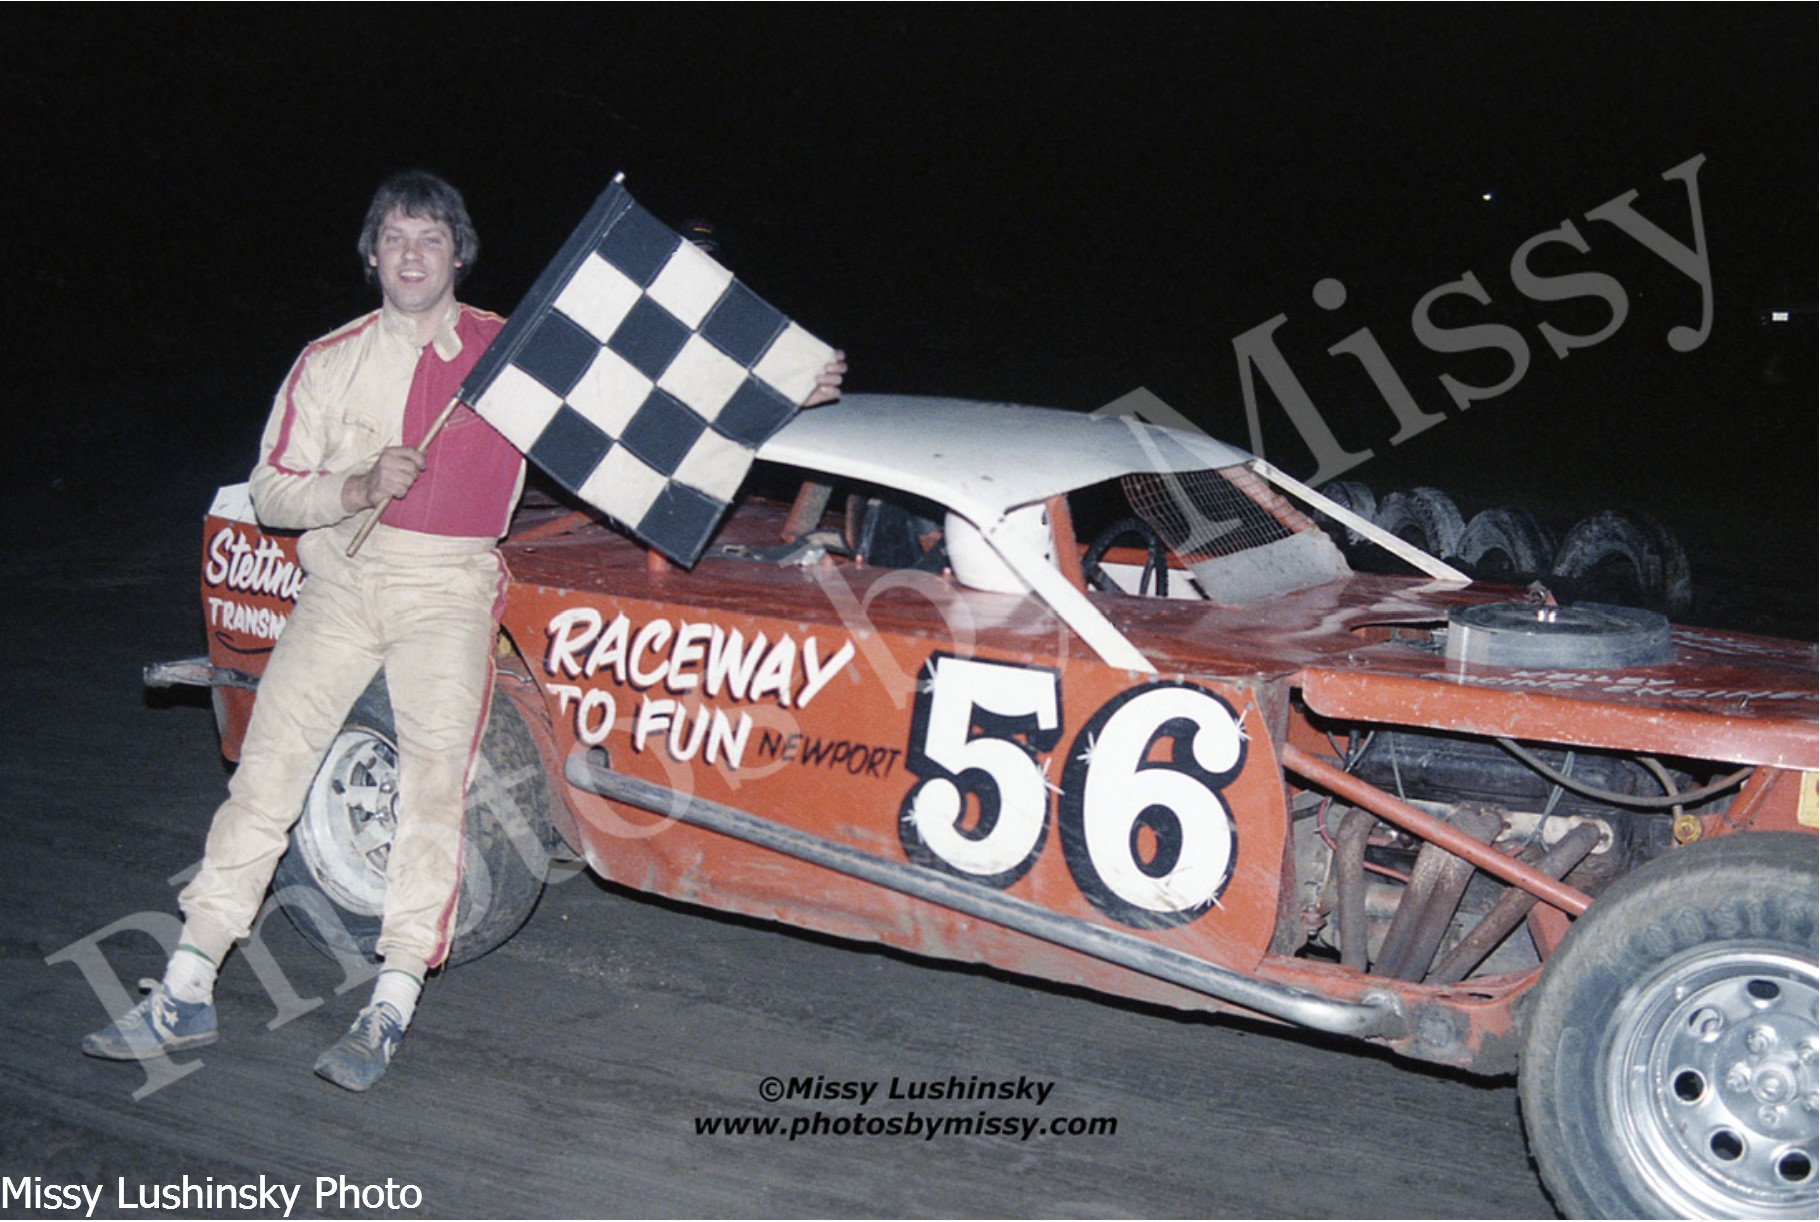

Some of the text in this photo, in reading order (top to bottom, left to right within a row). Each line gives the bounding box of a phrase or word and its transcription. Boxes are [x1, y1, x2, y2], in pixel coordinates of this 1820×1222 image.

[545, 606, 856, 709] RACEWAY
[545, 682, 902, 779] TO FUN NEWPORT
[898, 650, 1249, 930] 56
